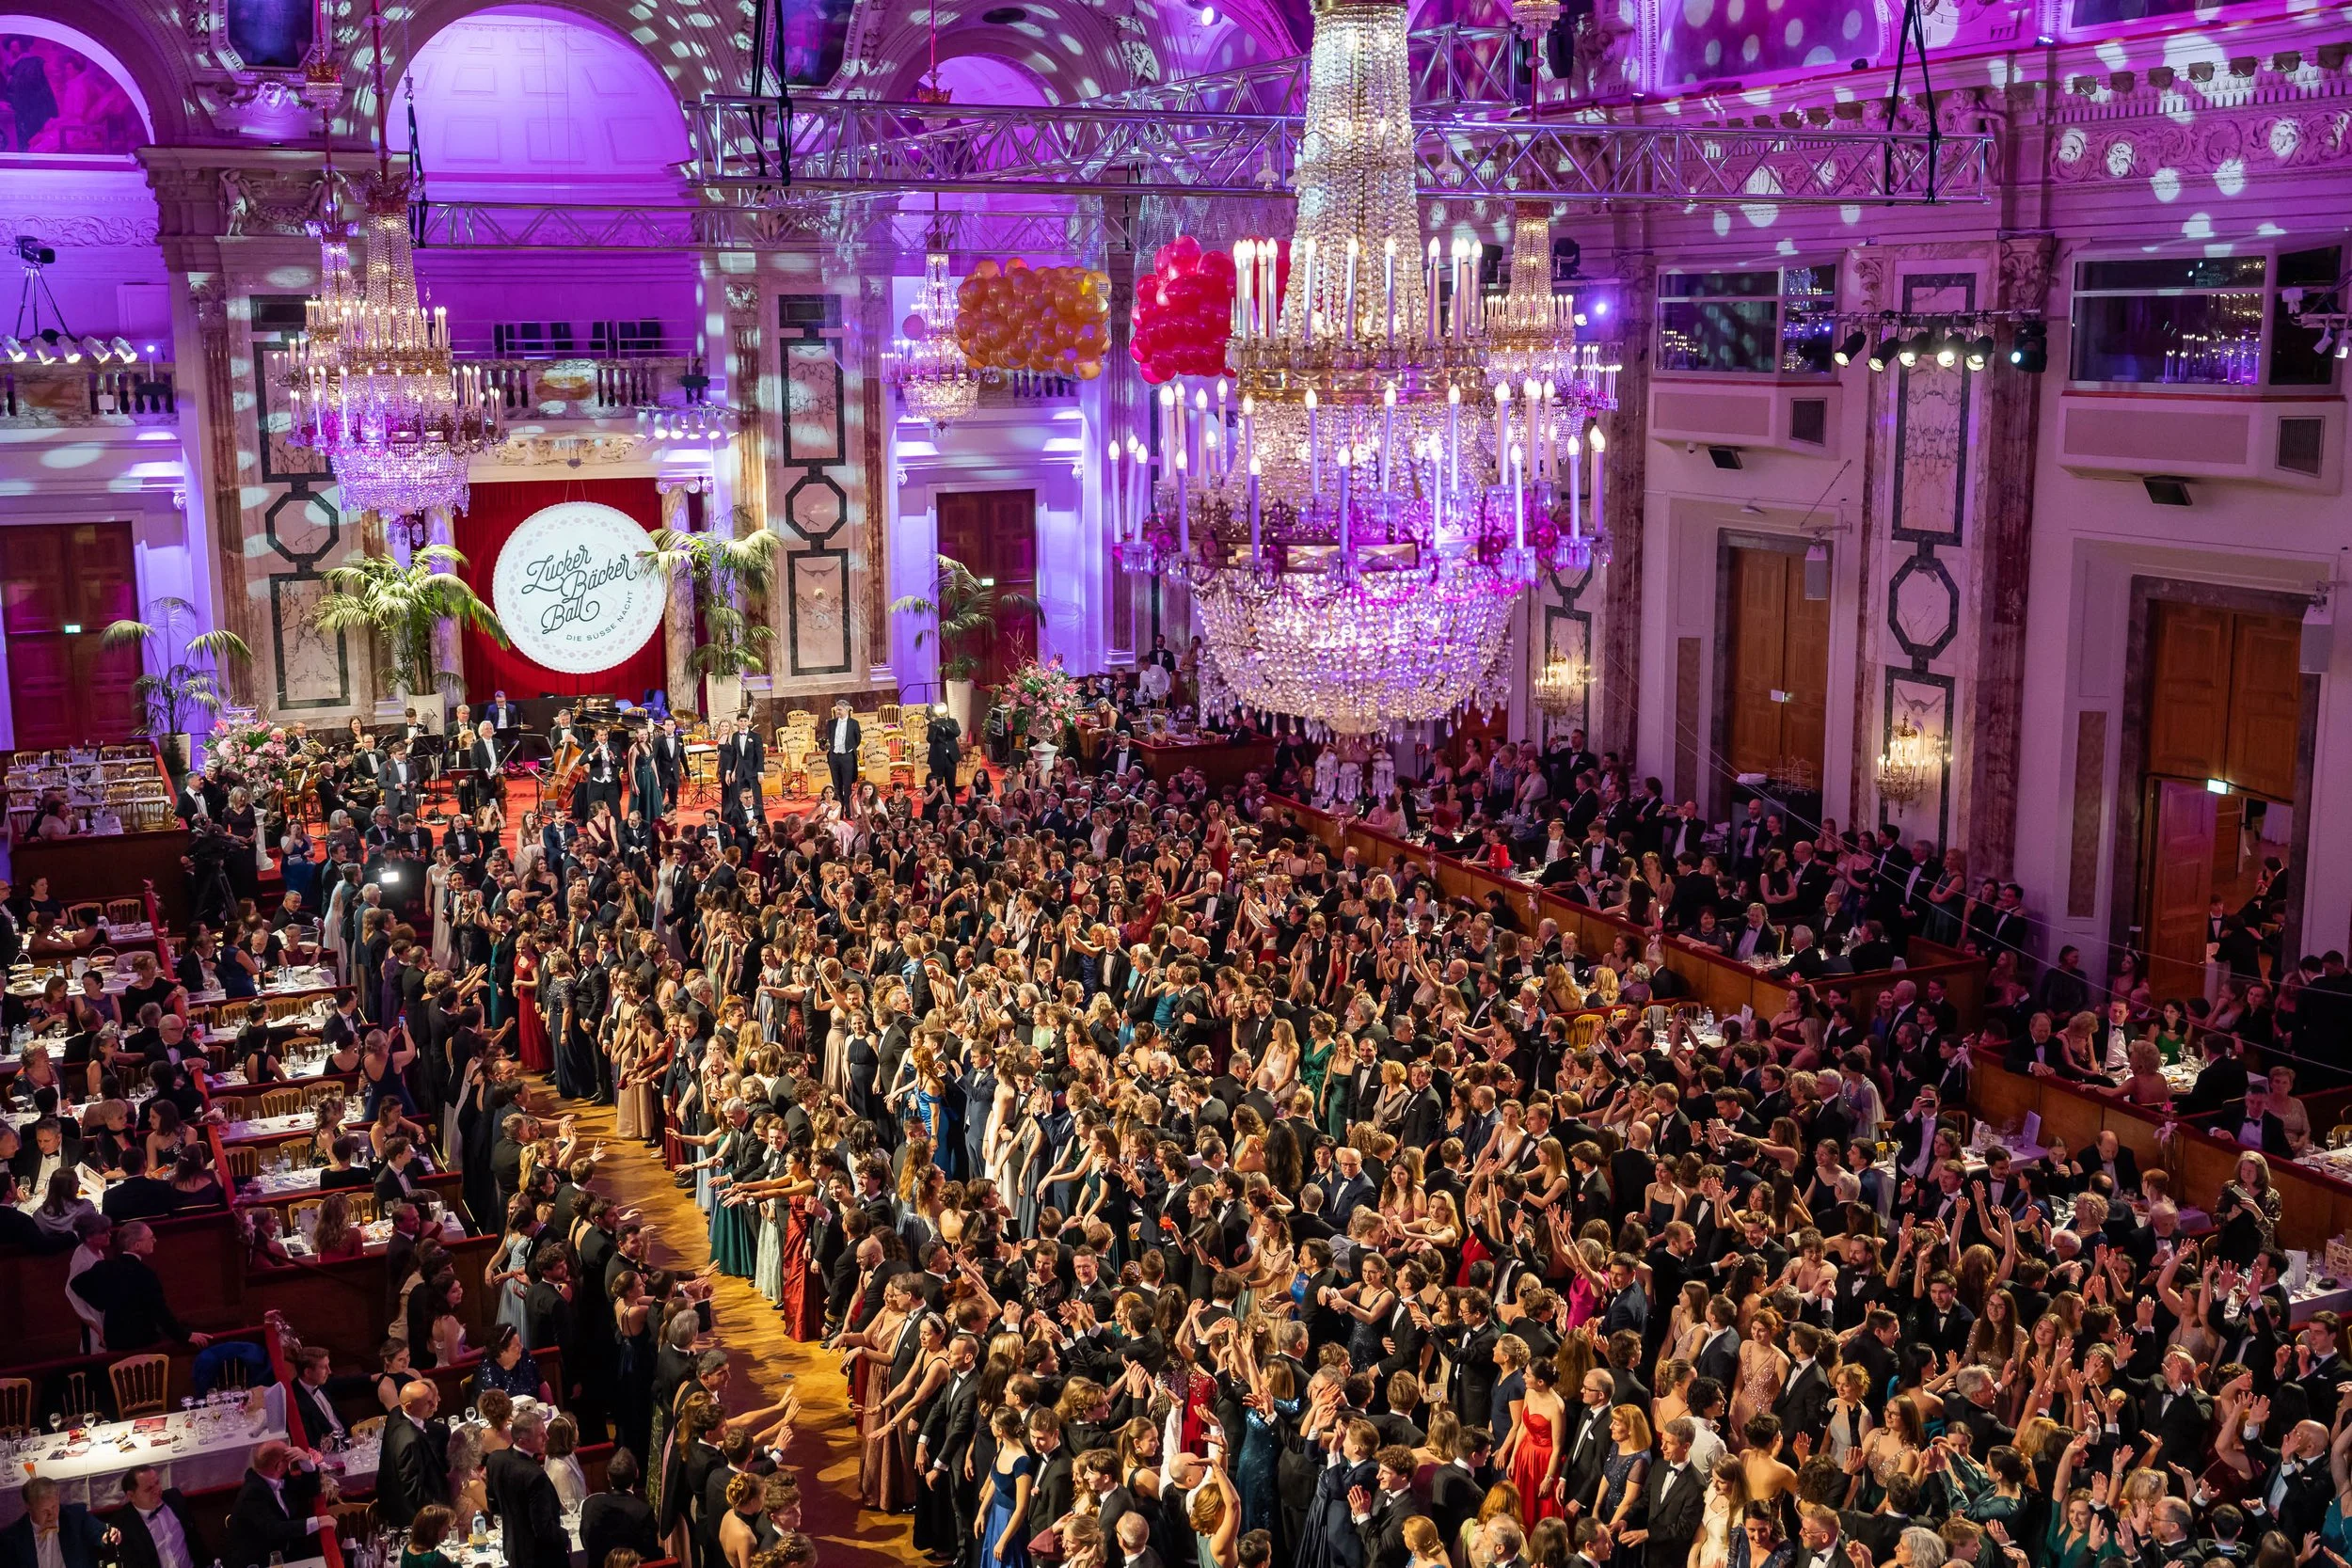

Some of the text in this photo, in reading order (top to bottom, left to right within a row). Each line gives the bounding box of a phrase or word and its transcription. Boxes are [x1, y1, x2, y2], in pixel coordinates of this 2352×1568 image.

[521, 545, 592, 594] Zucker
[561, 553, 638, 604] Bäcker
[541, 594, 600, 635] Ball
[617, 591, 634, 623] NACHT
